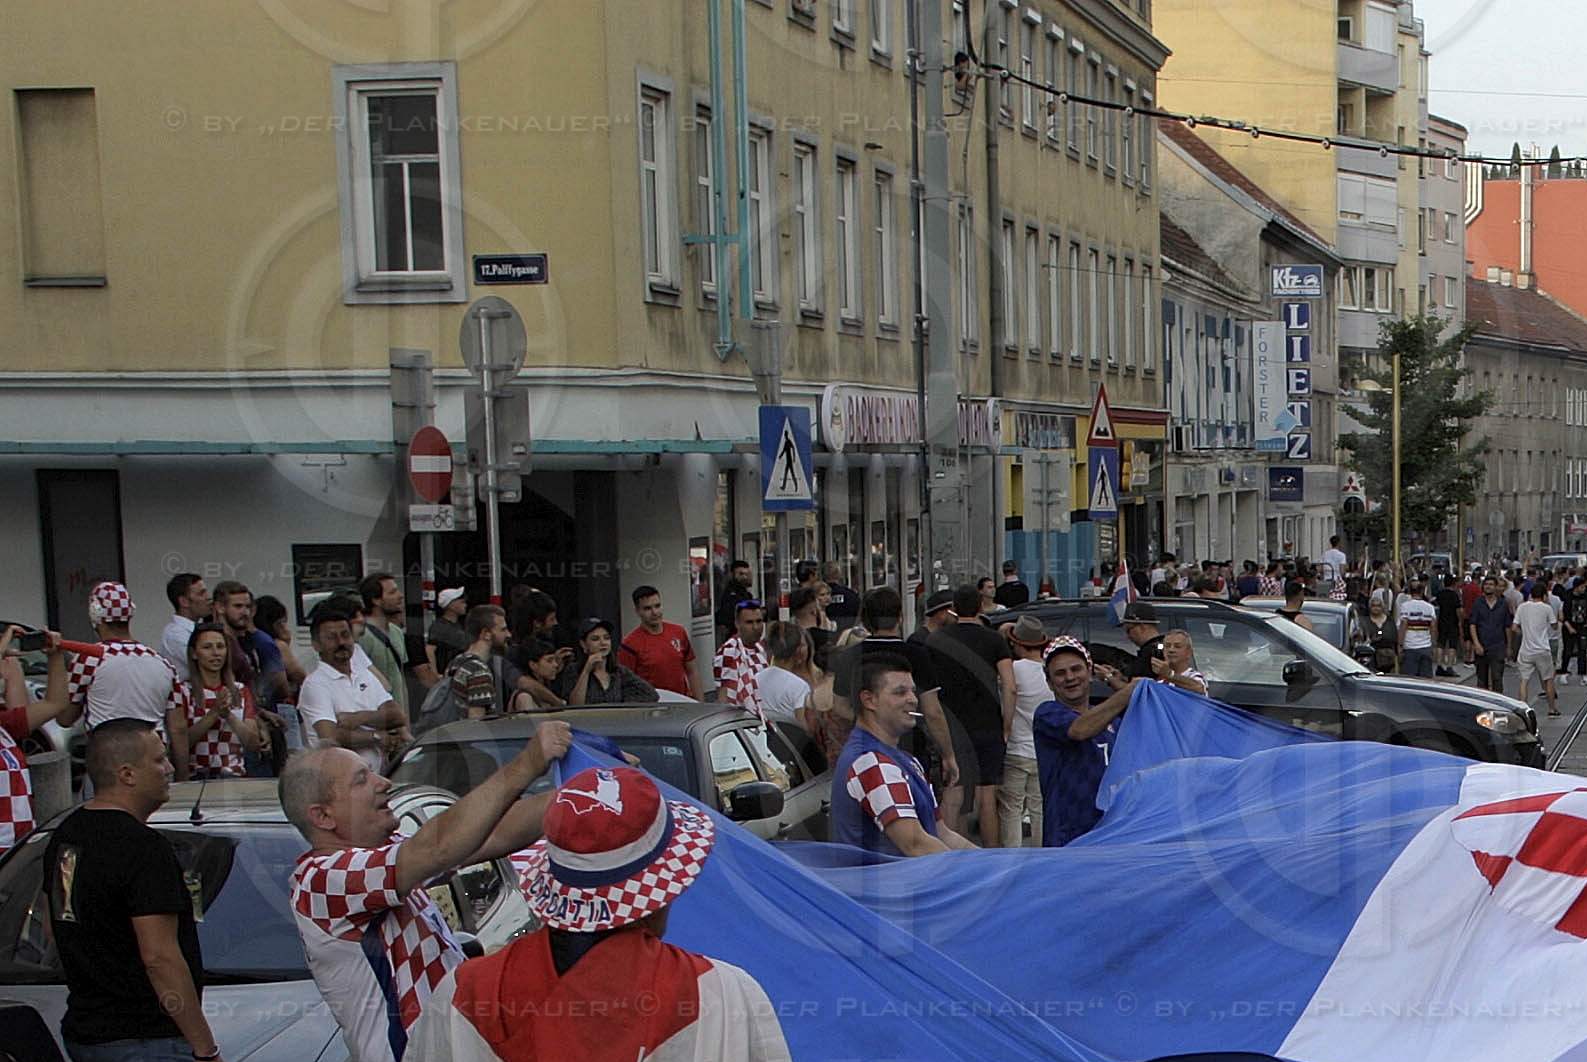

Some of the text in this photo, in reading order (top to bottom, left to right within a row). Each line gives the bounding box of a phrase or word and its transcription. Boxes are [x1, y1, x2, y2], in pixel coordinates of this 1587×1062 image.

[1258, 327, 1268, 422] FORSTER
[1287, 304, 1308, 458] LIETZ
[1097, 743, 1108, 766] 7
[530, 875, 612, 923] CROATIA
